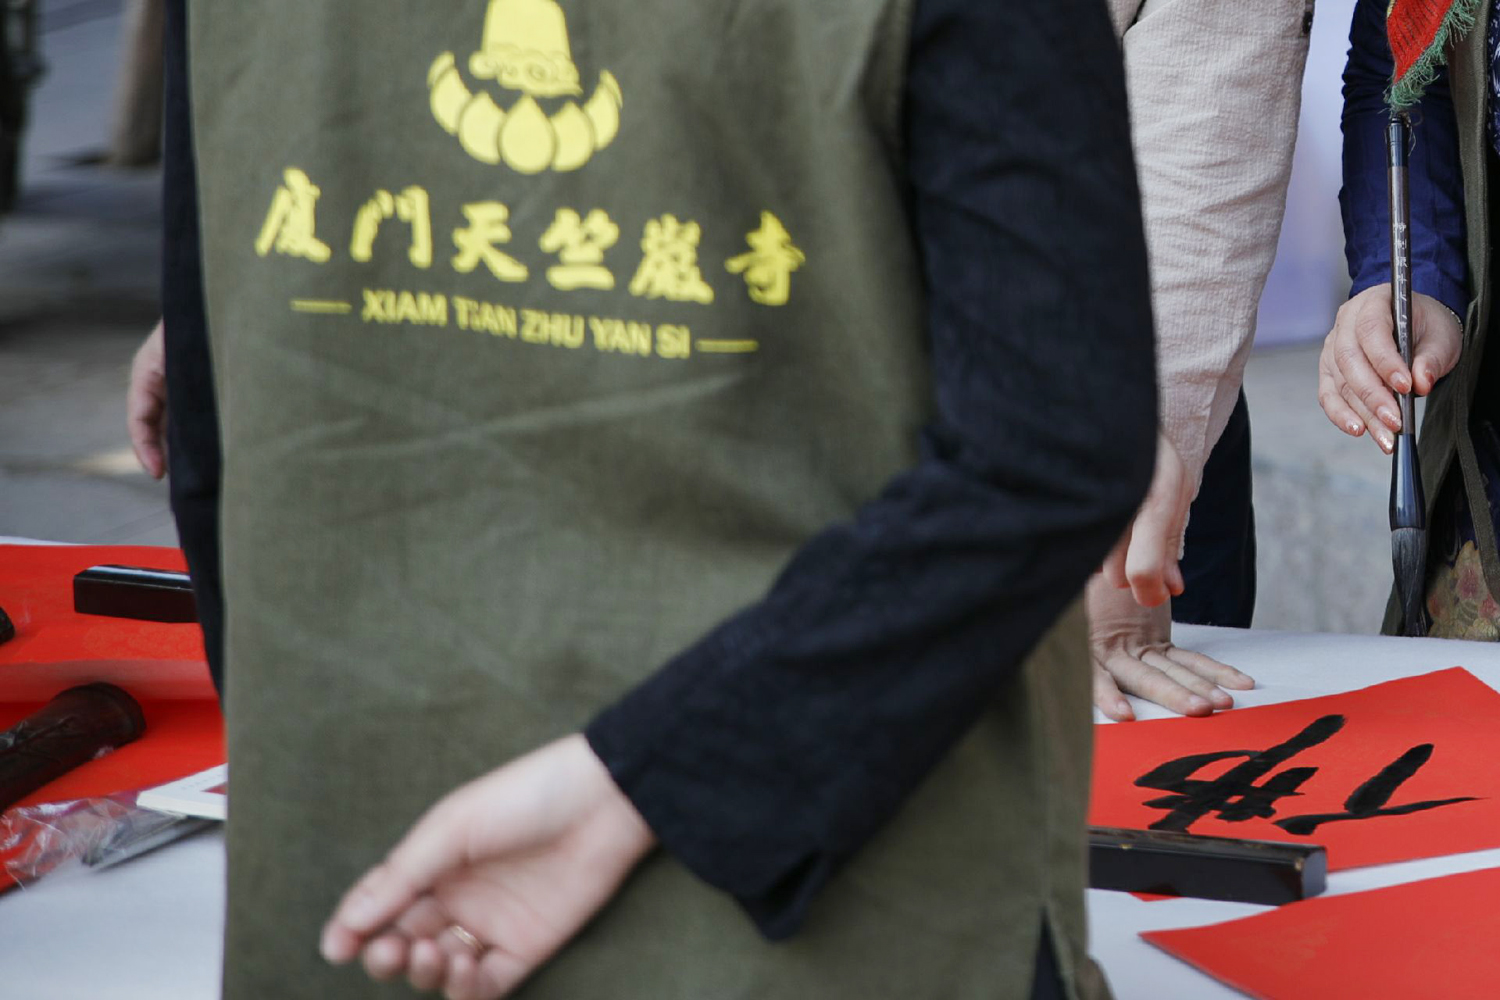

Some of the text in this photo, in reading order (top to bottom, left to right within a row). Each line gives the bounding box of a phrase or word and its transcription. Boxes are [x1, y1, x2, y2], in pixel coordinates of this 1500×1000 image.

[362, 288, 691, 360] XIAM TIAN ZHU YAN SI
